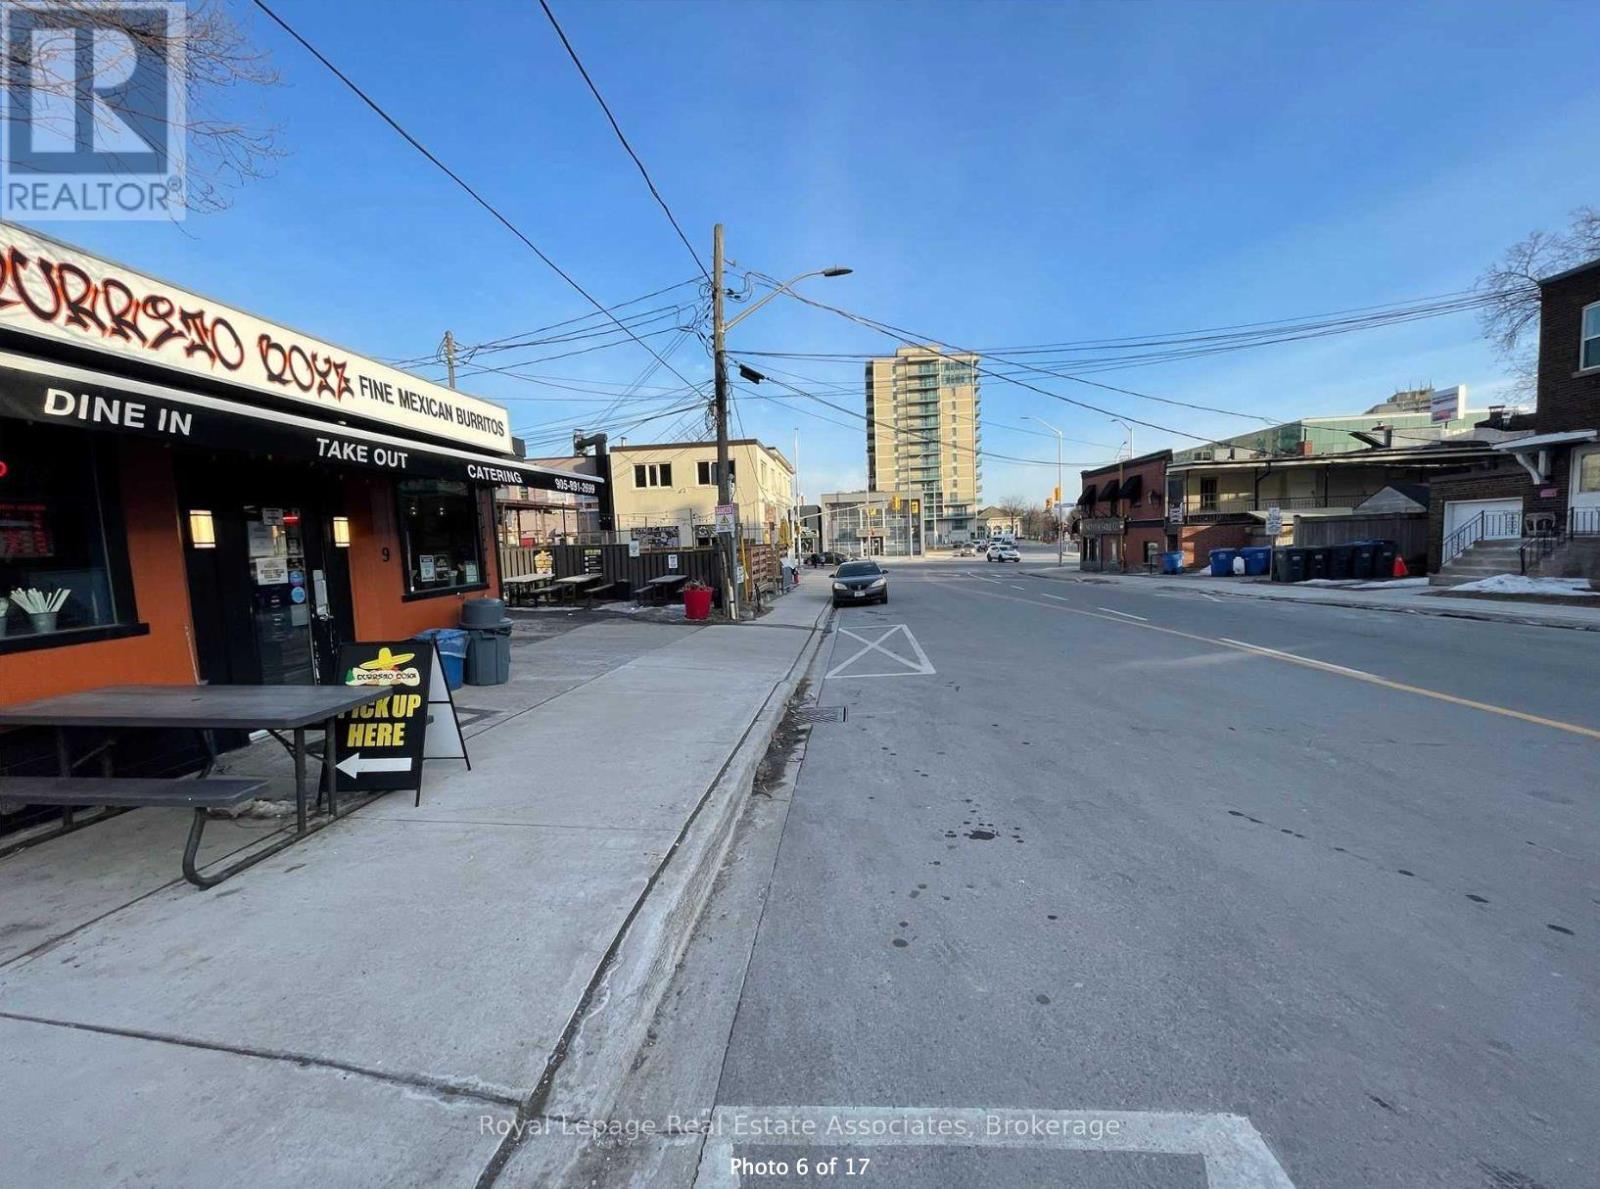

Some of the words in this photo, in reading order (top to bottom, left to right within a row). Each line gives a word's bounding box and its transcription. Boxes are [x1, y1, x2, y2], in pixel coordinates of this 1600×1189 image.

[257, 333, 354, 403] BOYZ
[43, 387, 146, 429] DINE
[157, 407, 193, 436] IN
[358, 374, 395, 405] FINE
[398, 387, 454, 422] MEXICAN
[456, 406, 505, 438] BURRITOS
[316, 437, 368, 464] TAKE
[373, 448, 409, 469] OUT
[467, 464, 522, 484] CATERING
[382, 547, 390, 562] 9
[338, 695, 390, 719] ICK
[391, 693, 422, 718] UP
[346, 722, 406, 748] HERE
